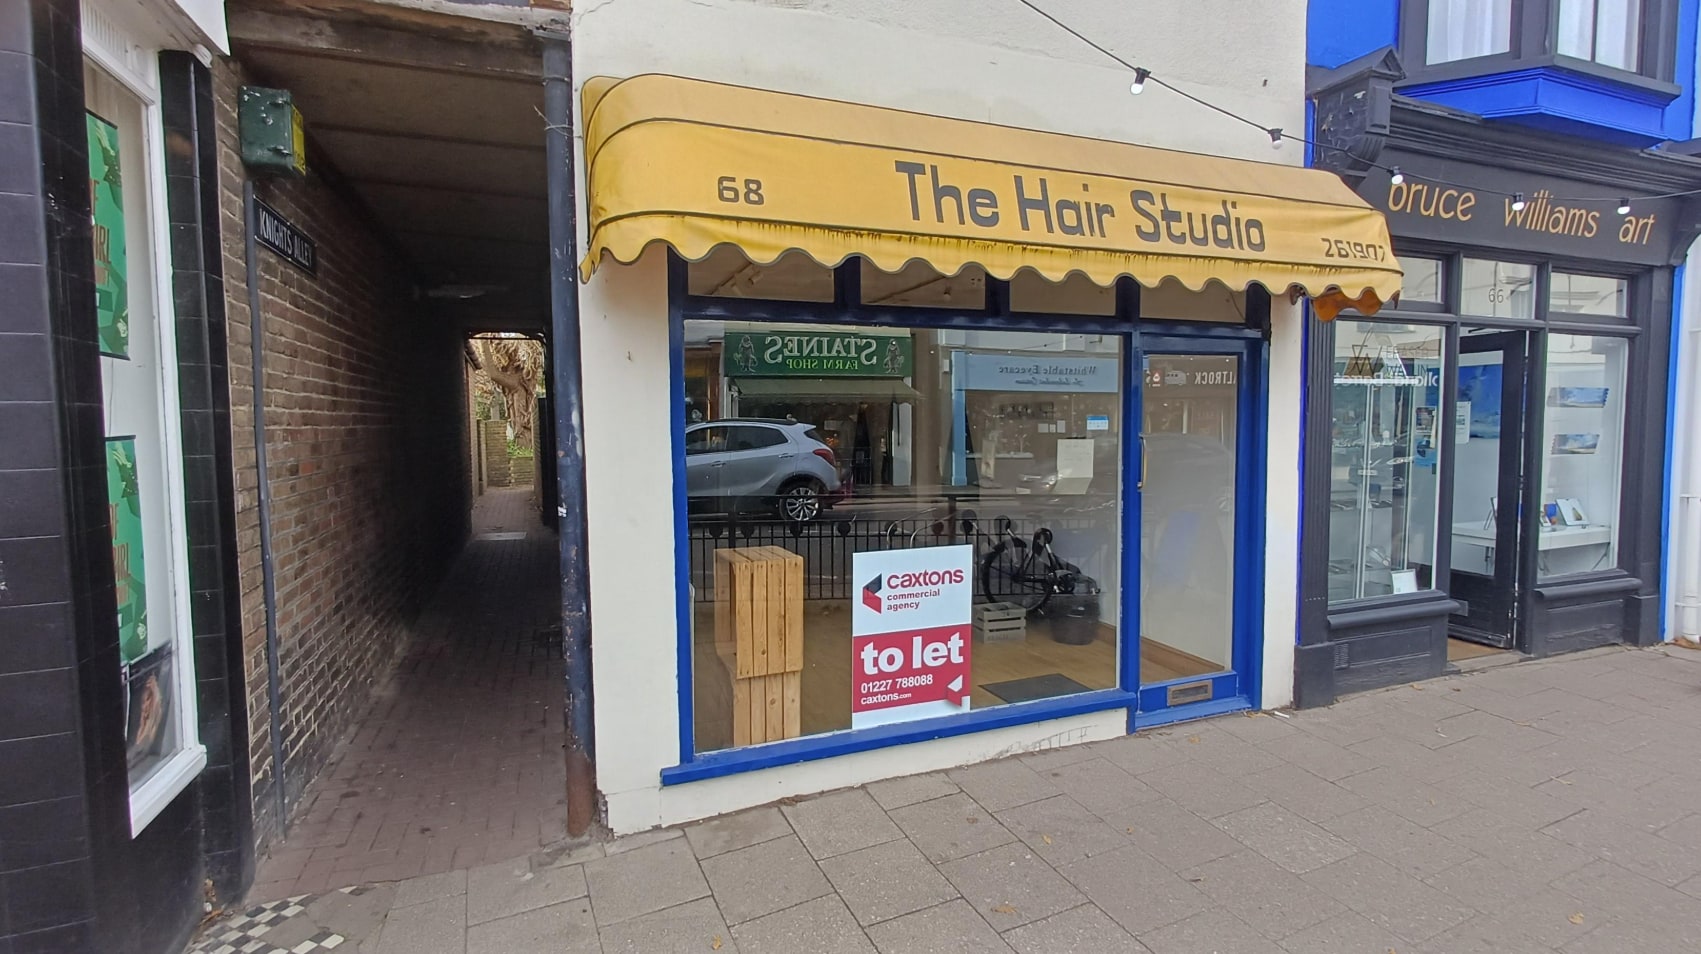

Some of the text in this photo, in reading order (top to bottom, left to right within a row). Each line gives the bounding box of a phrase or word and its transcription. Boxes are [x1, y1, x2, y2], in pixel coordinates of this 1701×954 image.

[717, 175, 765, 206] 68
[894, 159, 1266, 253] The Hair Studio
[1388, 180, 1656, 246] bruce williams art
[259, 207, 313, 268] KNIGHTS ALLEY
[1322, 237, 1387, 263] 261907
[1487, 288, 1505, 304] 66
[886, 569, 964, 590] caxtons
[886, 588, 940, 601] commercial
[886, 601, 920, 612] agency
[860, 631, 964, 676] to let
[860, 673, 934, 694] 01227 788088
[860, 691, 912, 706] caxtons.com
